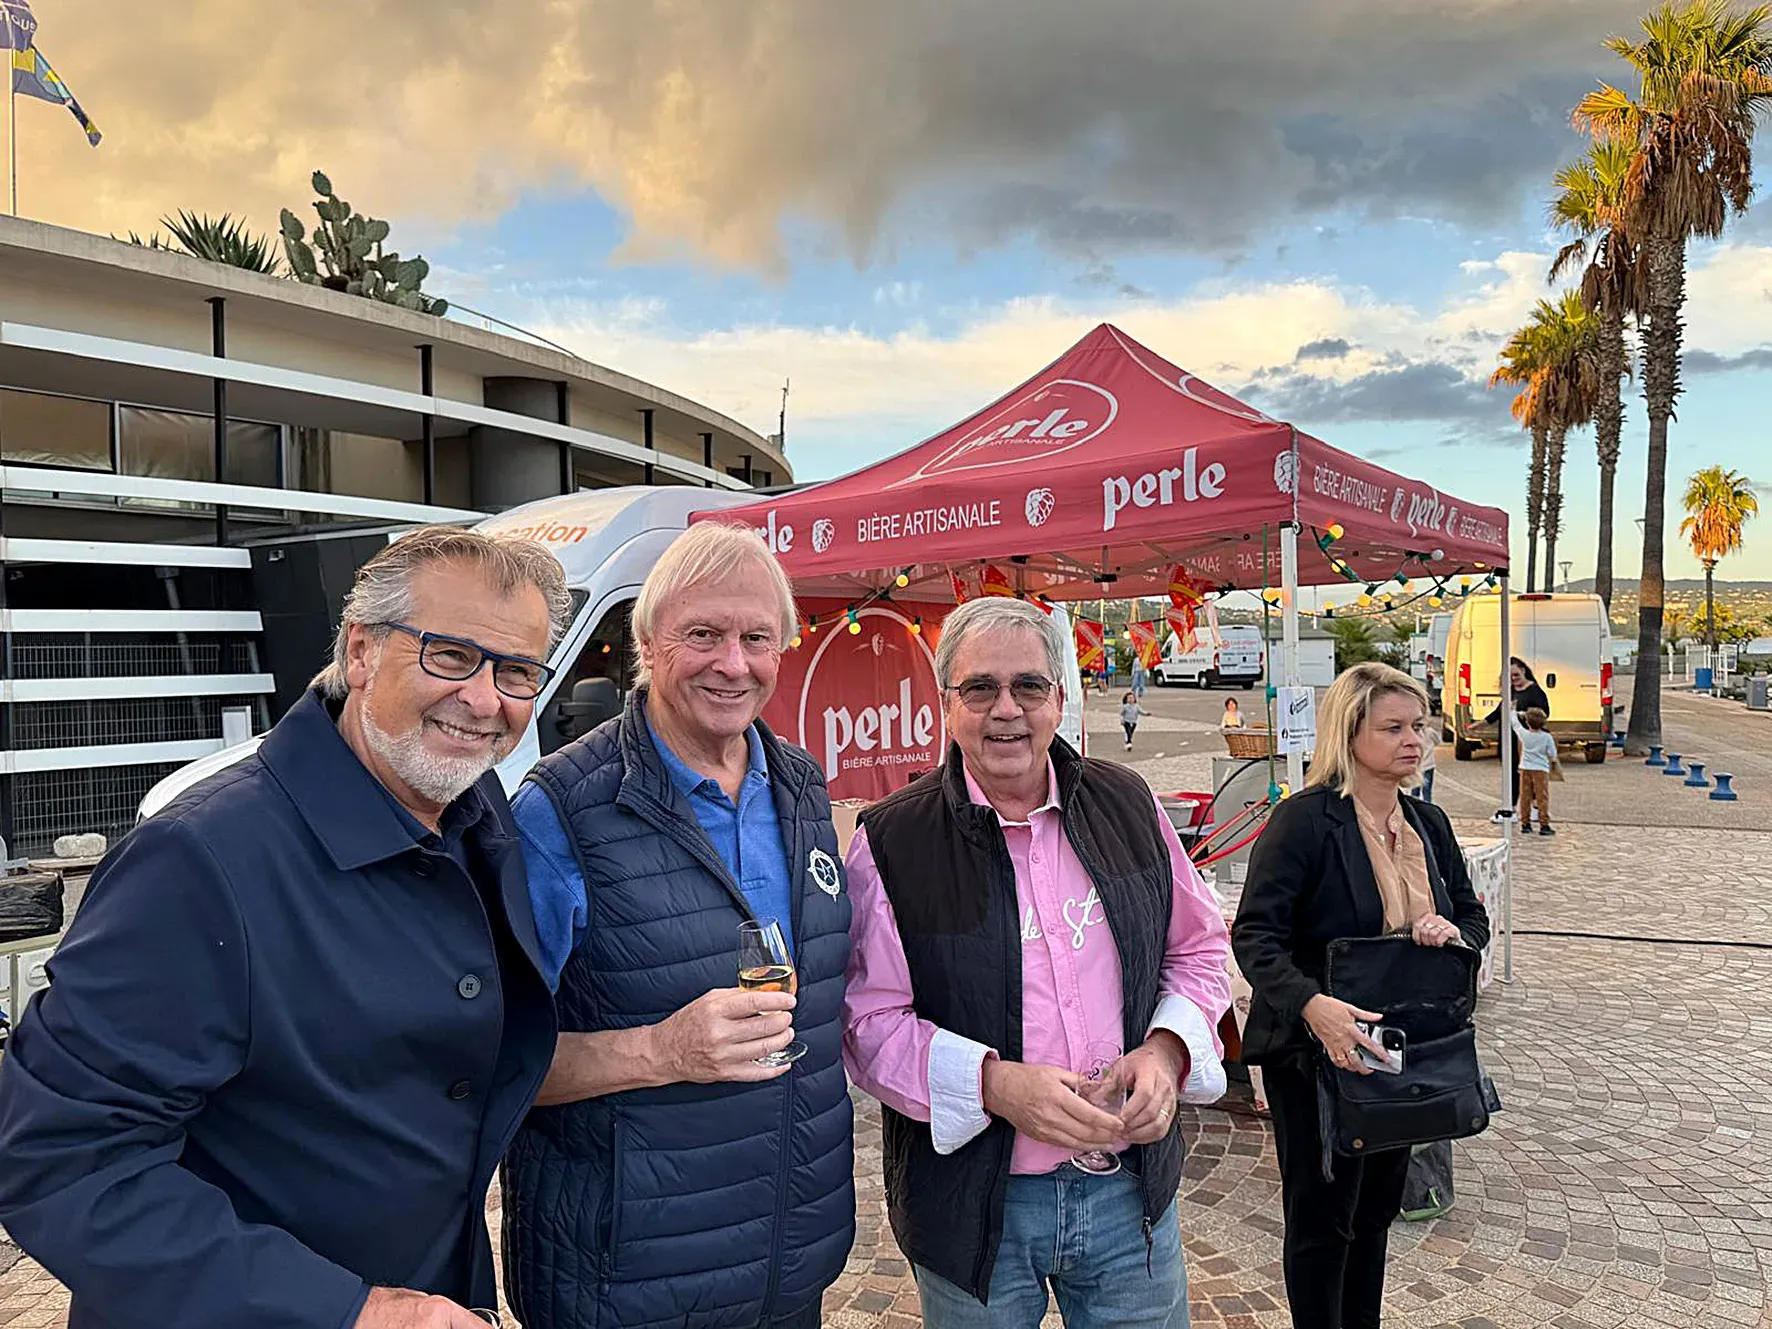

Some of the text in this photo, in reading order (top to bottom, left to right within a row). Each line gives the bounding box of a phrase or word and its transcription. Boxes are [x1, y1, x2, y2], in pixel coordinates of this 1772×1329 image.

[1103, 446, 1227, 532] perle
[1313, 461, 1388, 514] BIÈRE ARTISANALE
[857, 500, 1001, 543] BIÈRE ARTISANALE
[1406, 489, 1445, 538] perle
[823, 677, 934, 782] perle
[842, 752, 932, 770] BIÈRE ARTISANALE
